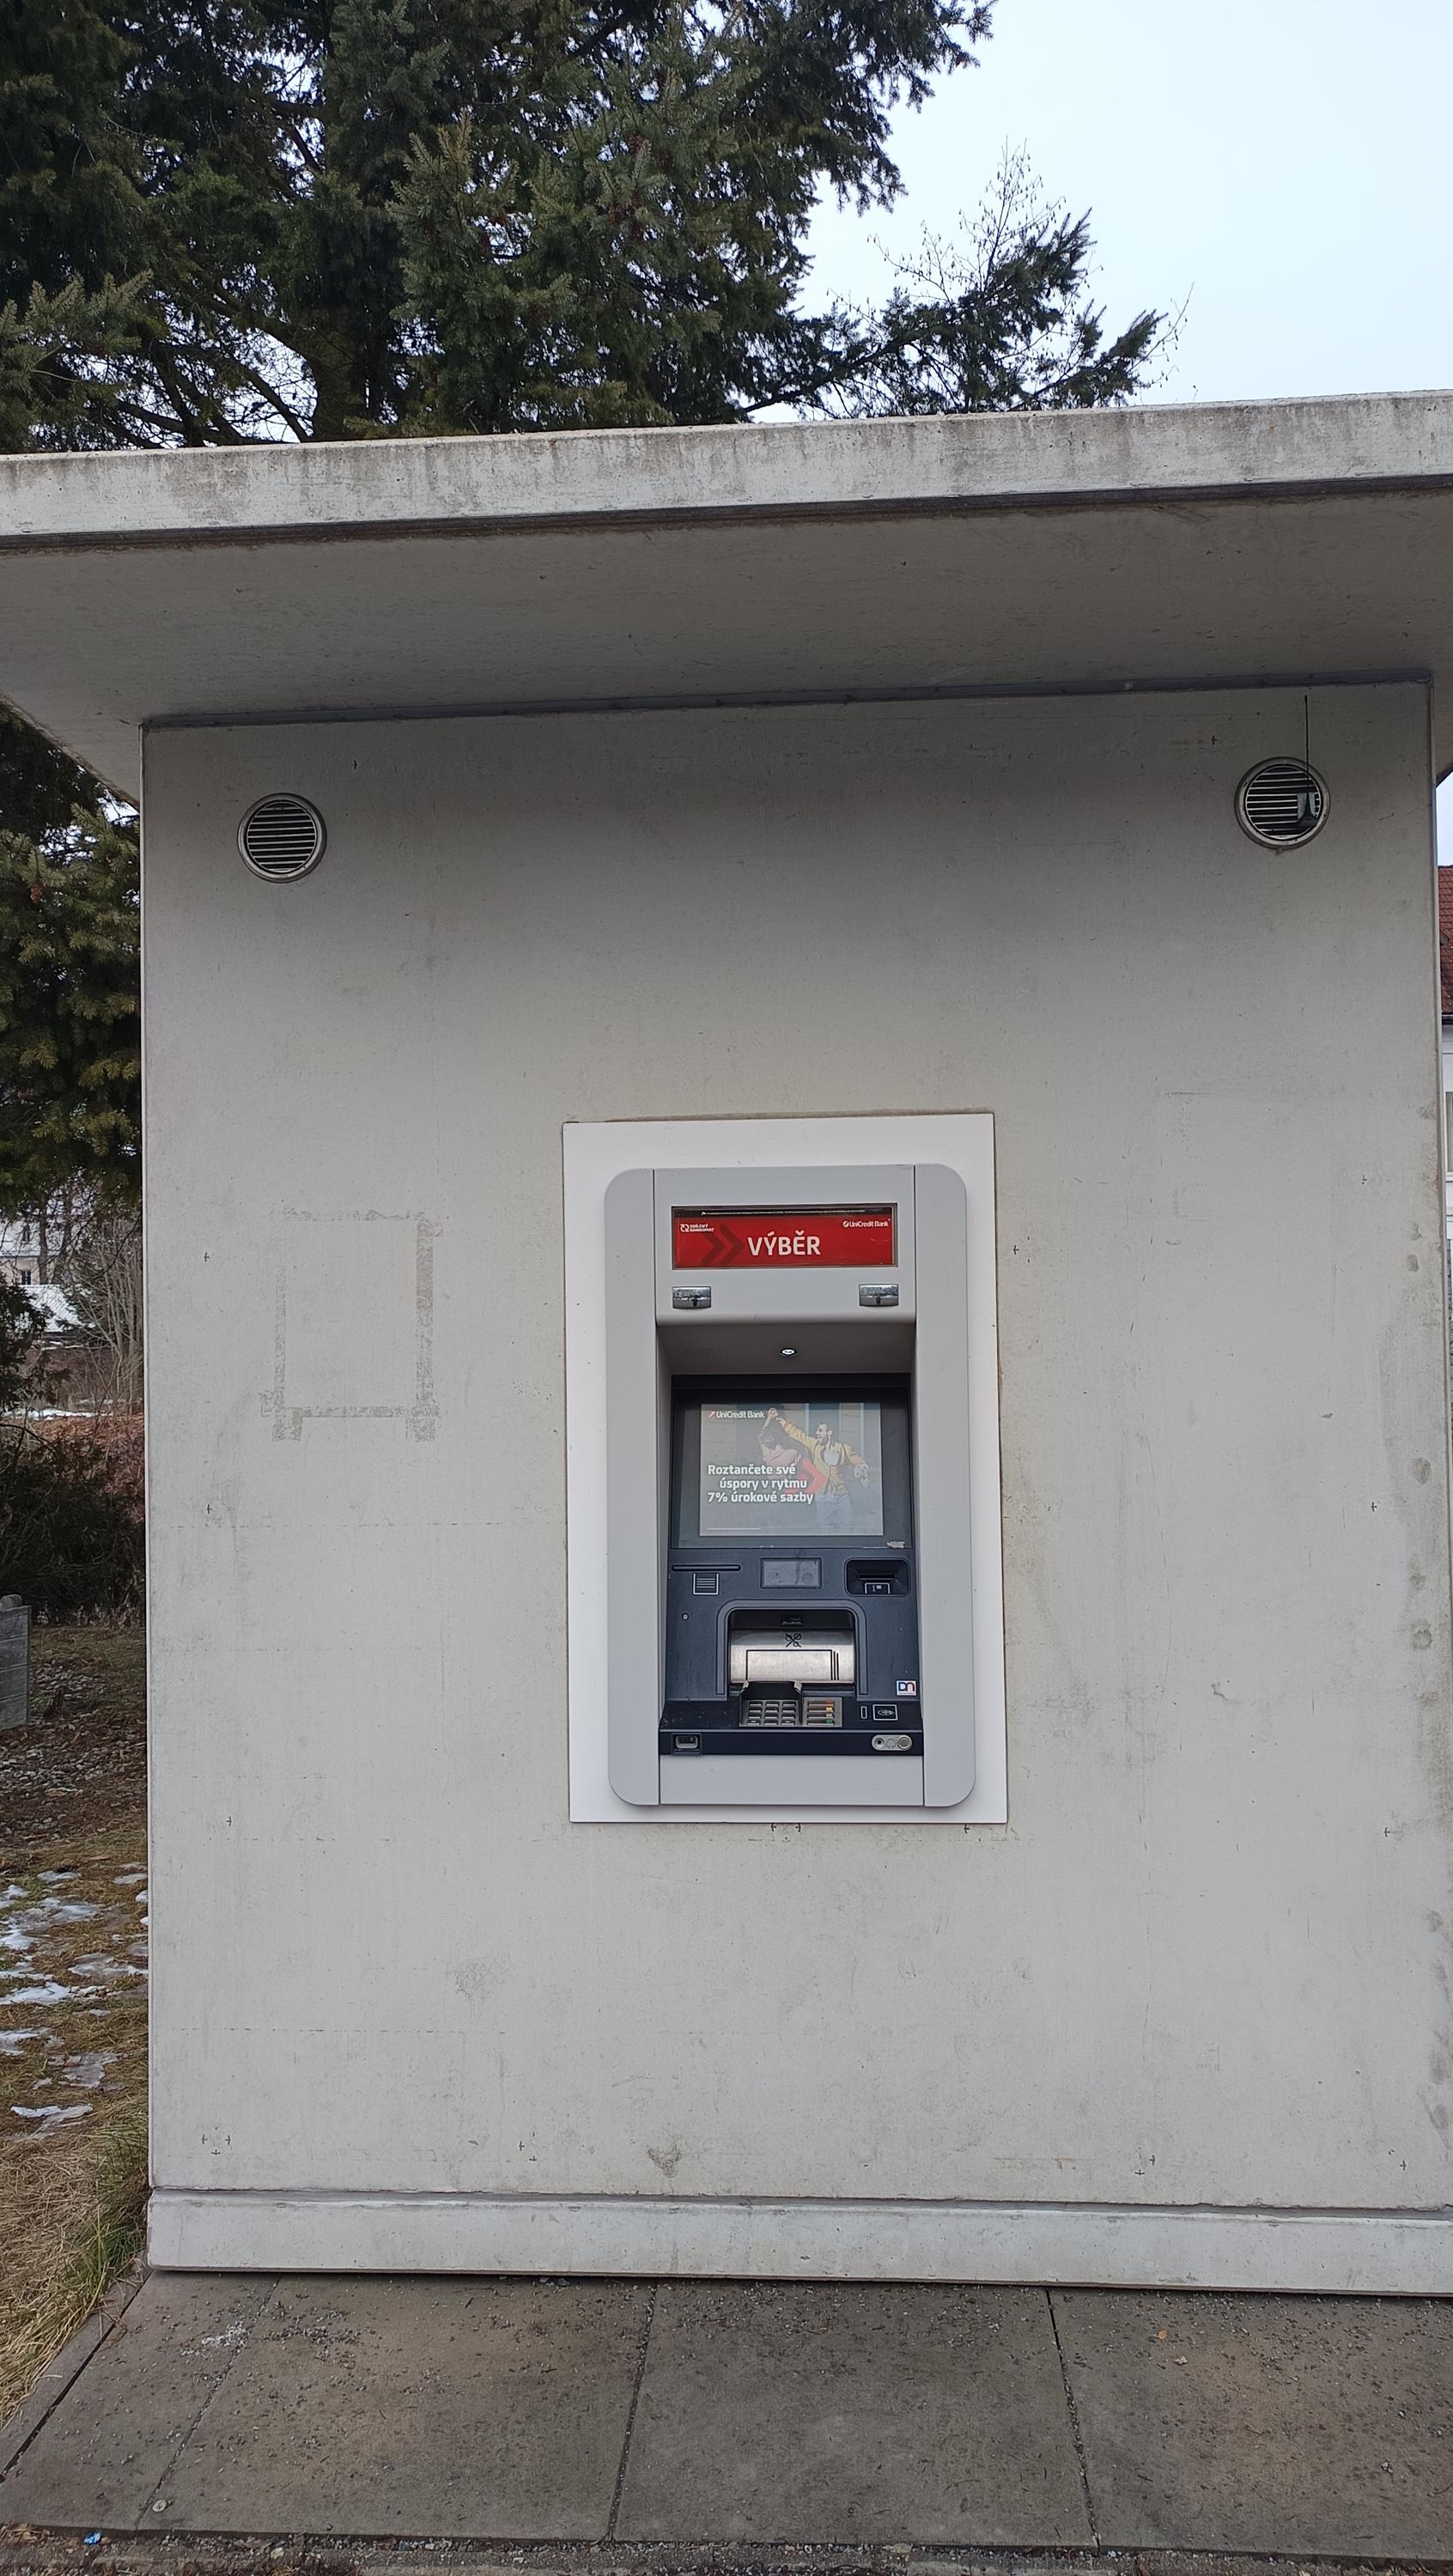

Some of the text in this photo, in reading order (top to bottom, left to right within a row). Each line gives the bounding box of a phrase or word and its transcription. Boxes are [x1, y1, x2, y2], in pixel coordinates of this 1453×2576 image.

[747, 1230, 821, 1256] VÝBĚR
[716, 1410, 765, 1419] UniCredit Bank
[708, 1463, 796, 1475] Roztančete své
[720, 1476, 759, 1492] úspory
[771, 1478, 807, 1492] rytmu
[707, 1492, 814, 1505] 7% úrokové sazby
